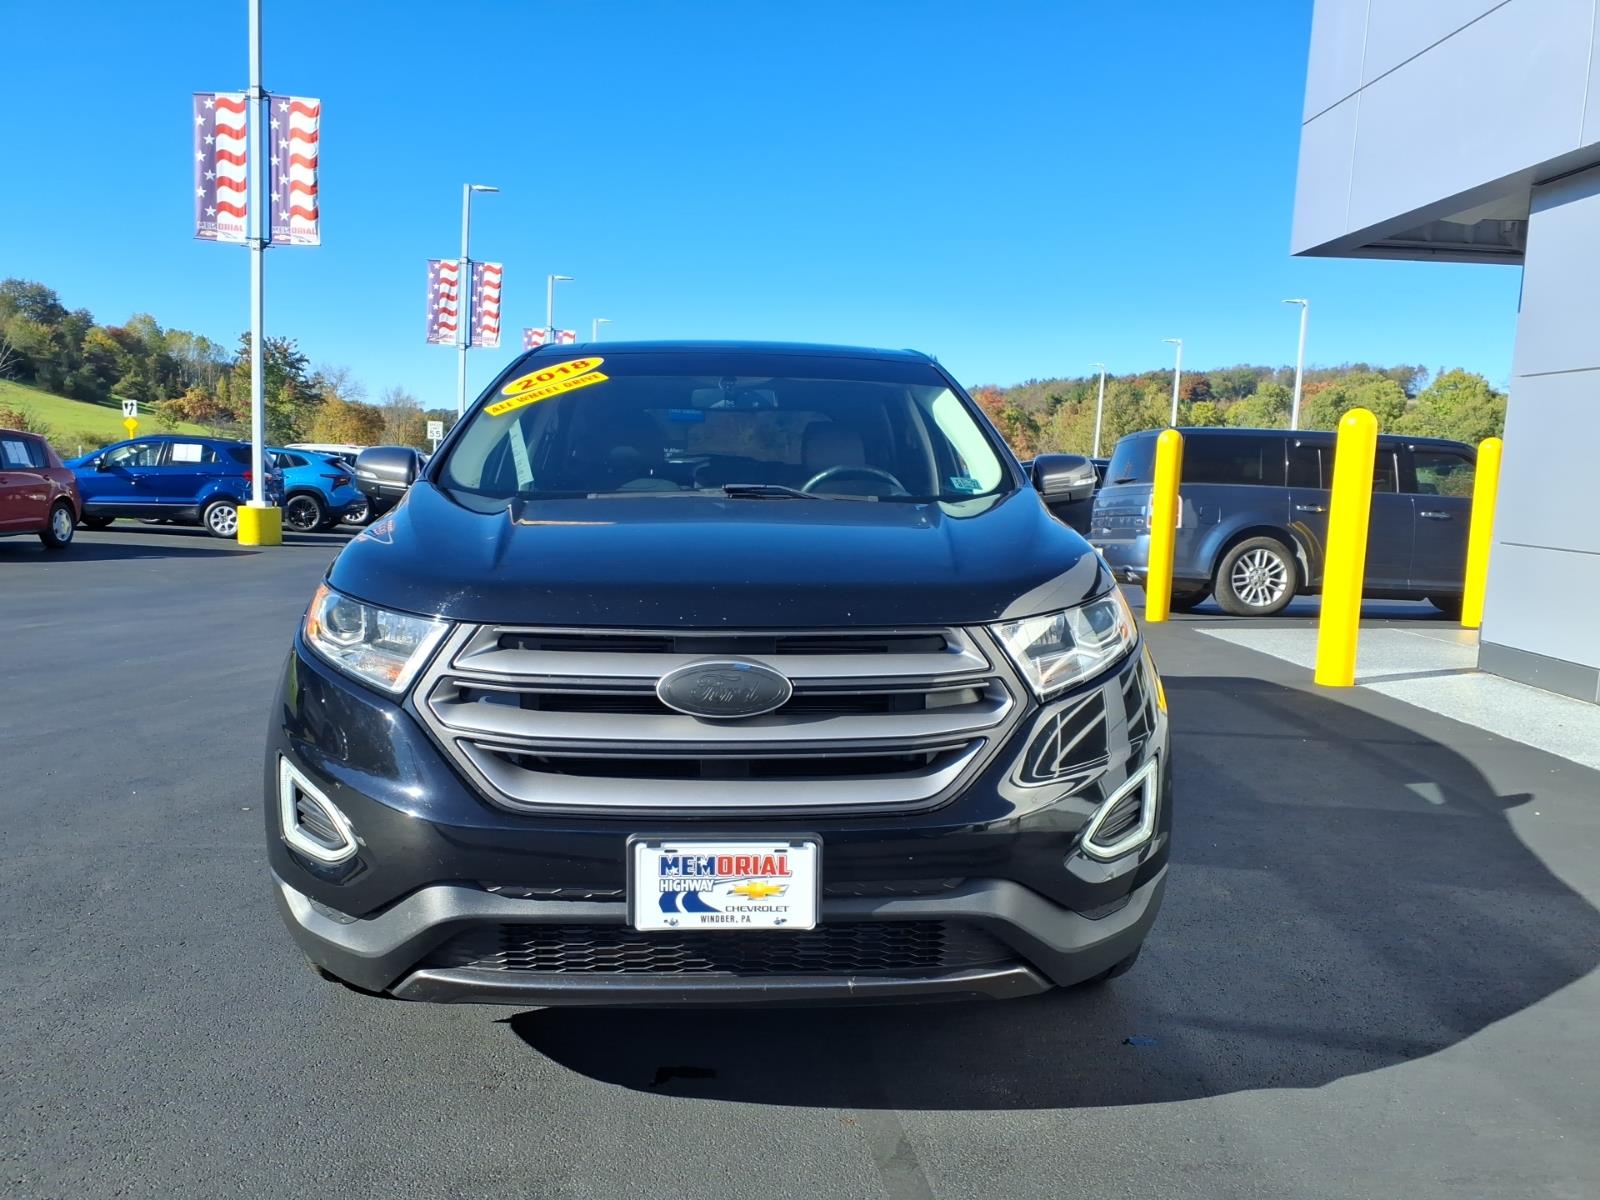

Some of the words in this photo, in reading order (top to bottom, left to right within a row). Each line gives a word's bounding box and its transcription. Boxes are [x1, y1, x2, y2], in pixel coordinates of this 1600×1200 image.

[516, 360, 590, 391] 2018
[491, 401, 513, 414] ALL
[516, 385, 560, 403] WHEEL
[562, 374, 601, 388] DRIVE
[429, 430, 441, 438] 55
[659, 855, 792, 877] MEMORIAL
[659, 878, 715, 892] HIGHWAY
[725, 905, 790, 913] CHEVROLET
[741, 915, 751, 923] PA
